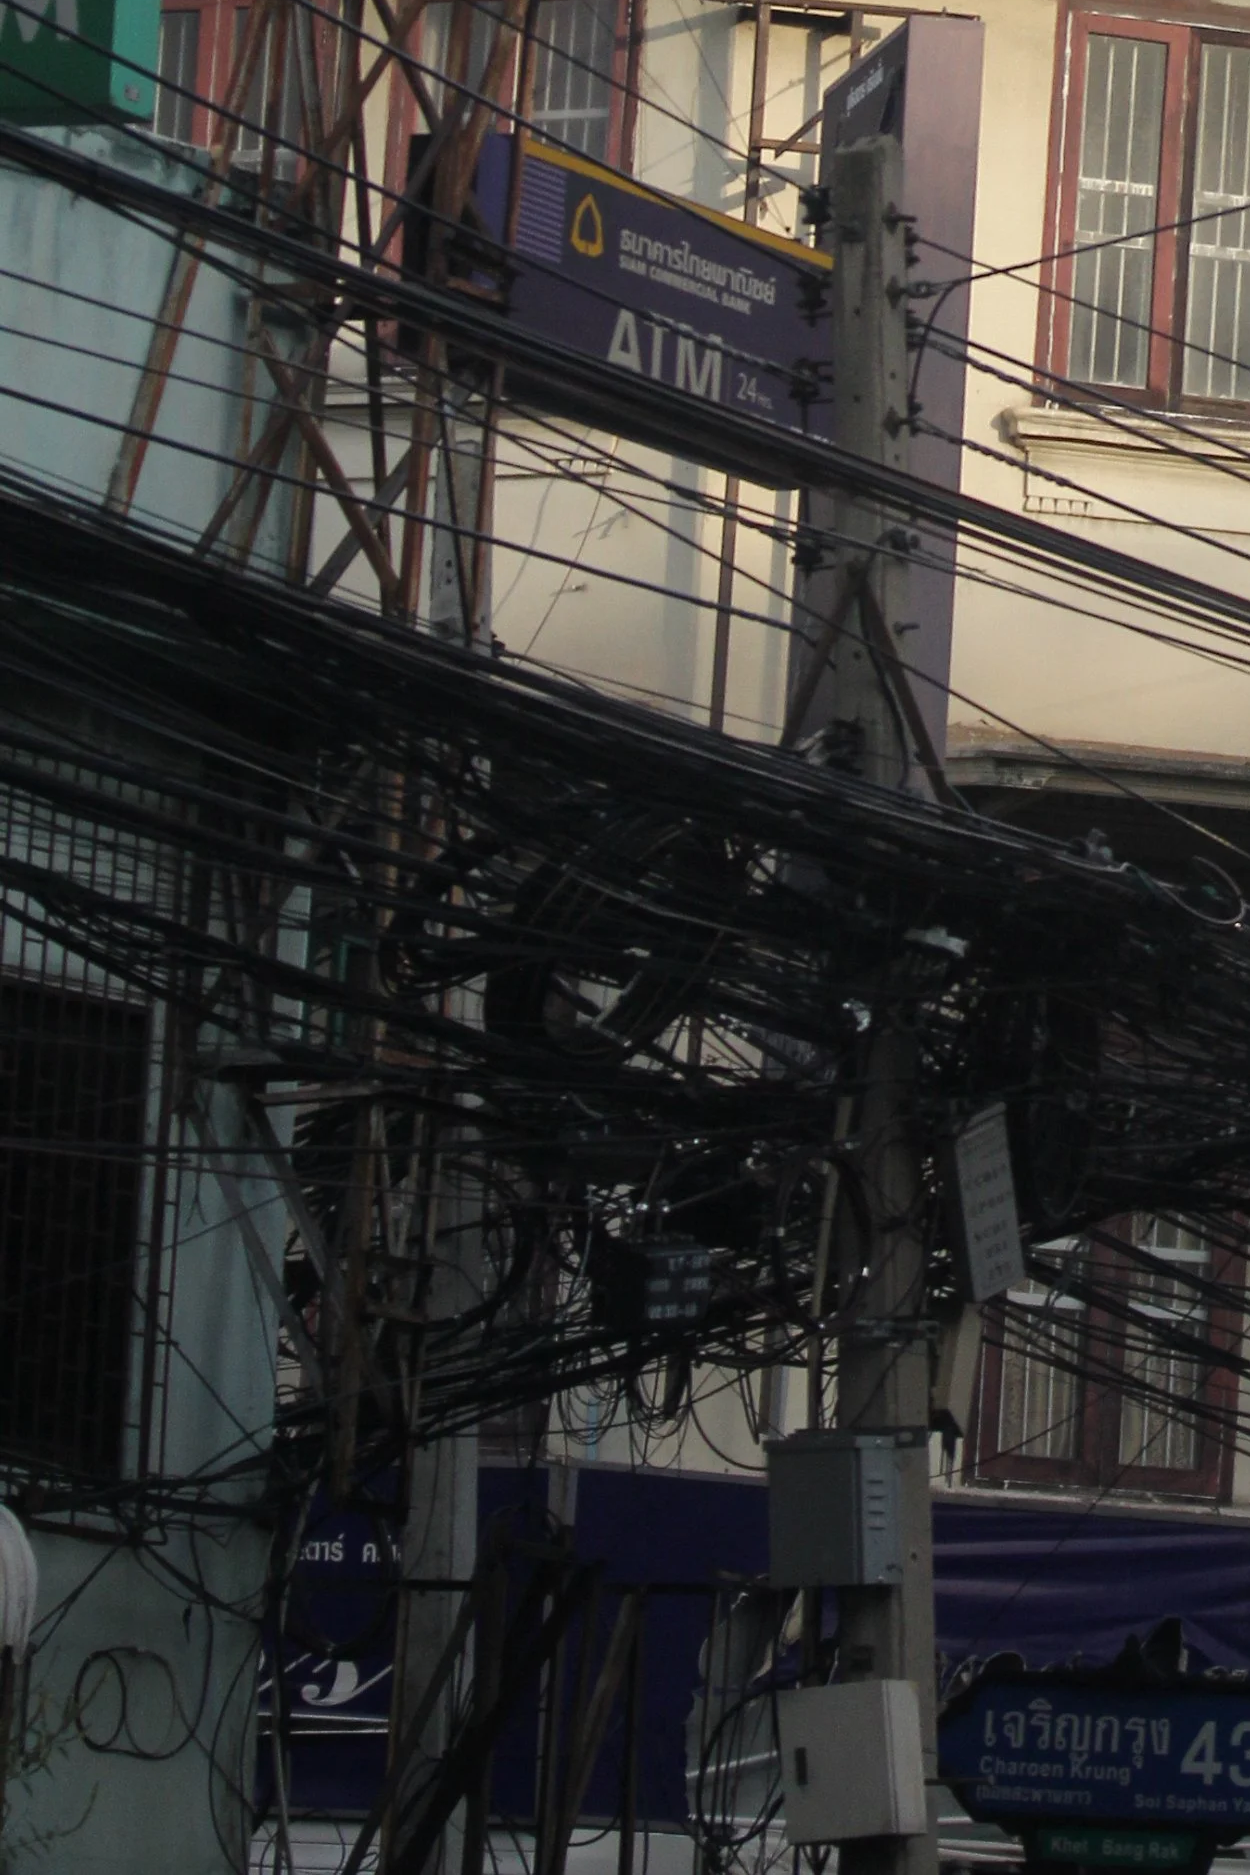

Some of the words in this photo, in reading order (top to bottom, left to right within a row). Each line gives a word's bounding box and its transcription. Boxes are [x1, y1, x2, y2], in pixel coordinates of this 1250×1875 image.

[606, 307, 724, 404] ATM
[736, 373, 758, 406] 24
[983, 1697, 1171, 1770] เจริญกรุง
[978, 1755, 1064, 1780] Charoen
[1069, 1759, 1132, 1787] Krung
[1133, 1792, 1161, 1810] Soi
[1166, 1795, 1229, 1814] Saphan
[1101, 1837, 1145, 1861] Bang
[1148, 1843, 1181, 1861] Rak
